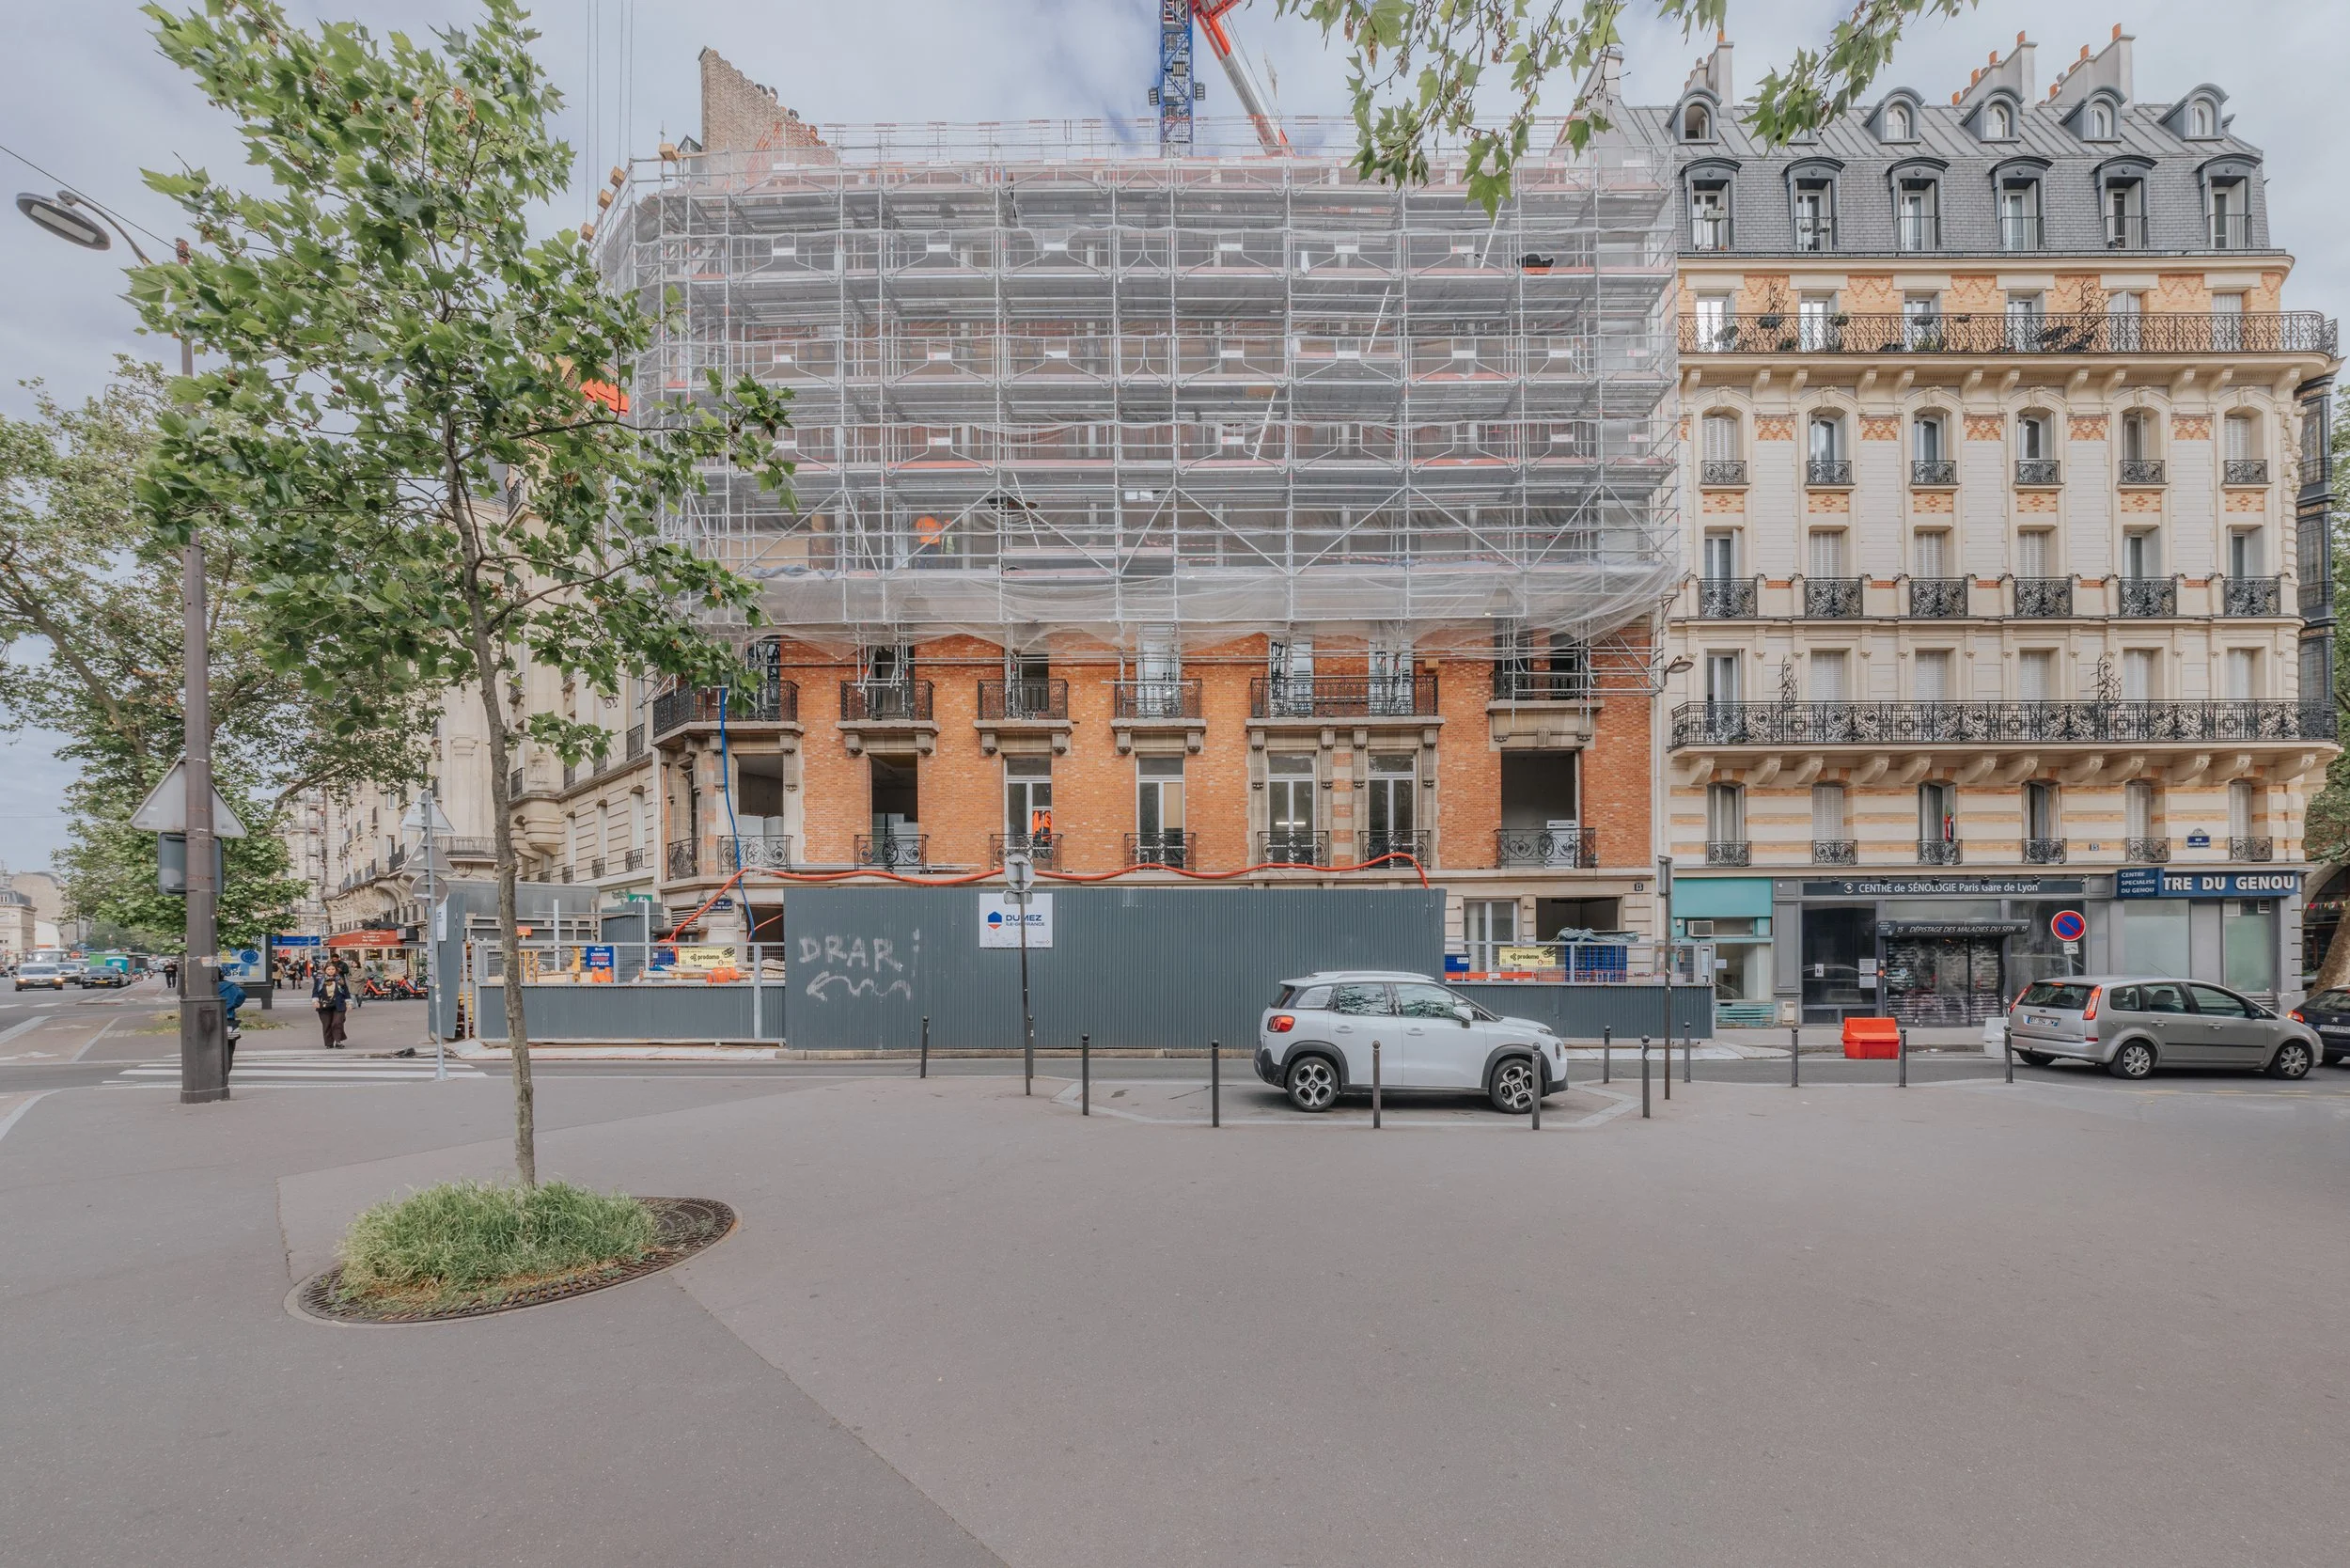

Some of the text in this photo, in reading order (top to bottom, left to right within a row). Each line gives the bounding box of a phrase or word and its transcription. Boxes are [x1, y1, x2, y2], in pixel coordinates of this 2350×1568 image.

[1858, 881, 2038, 893] CENTRE de SÉNOLOGIE Paris Gare de Lyon
[2163, 875, 2295, 890] TRE DU GENOU
